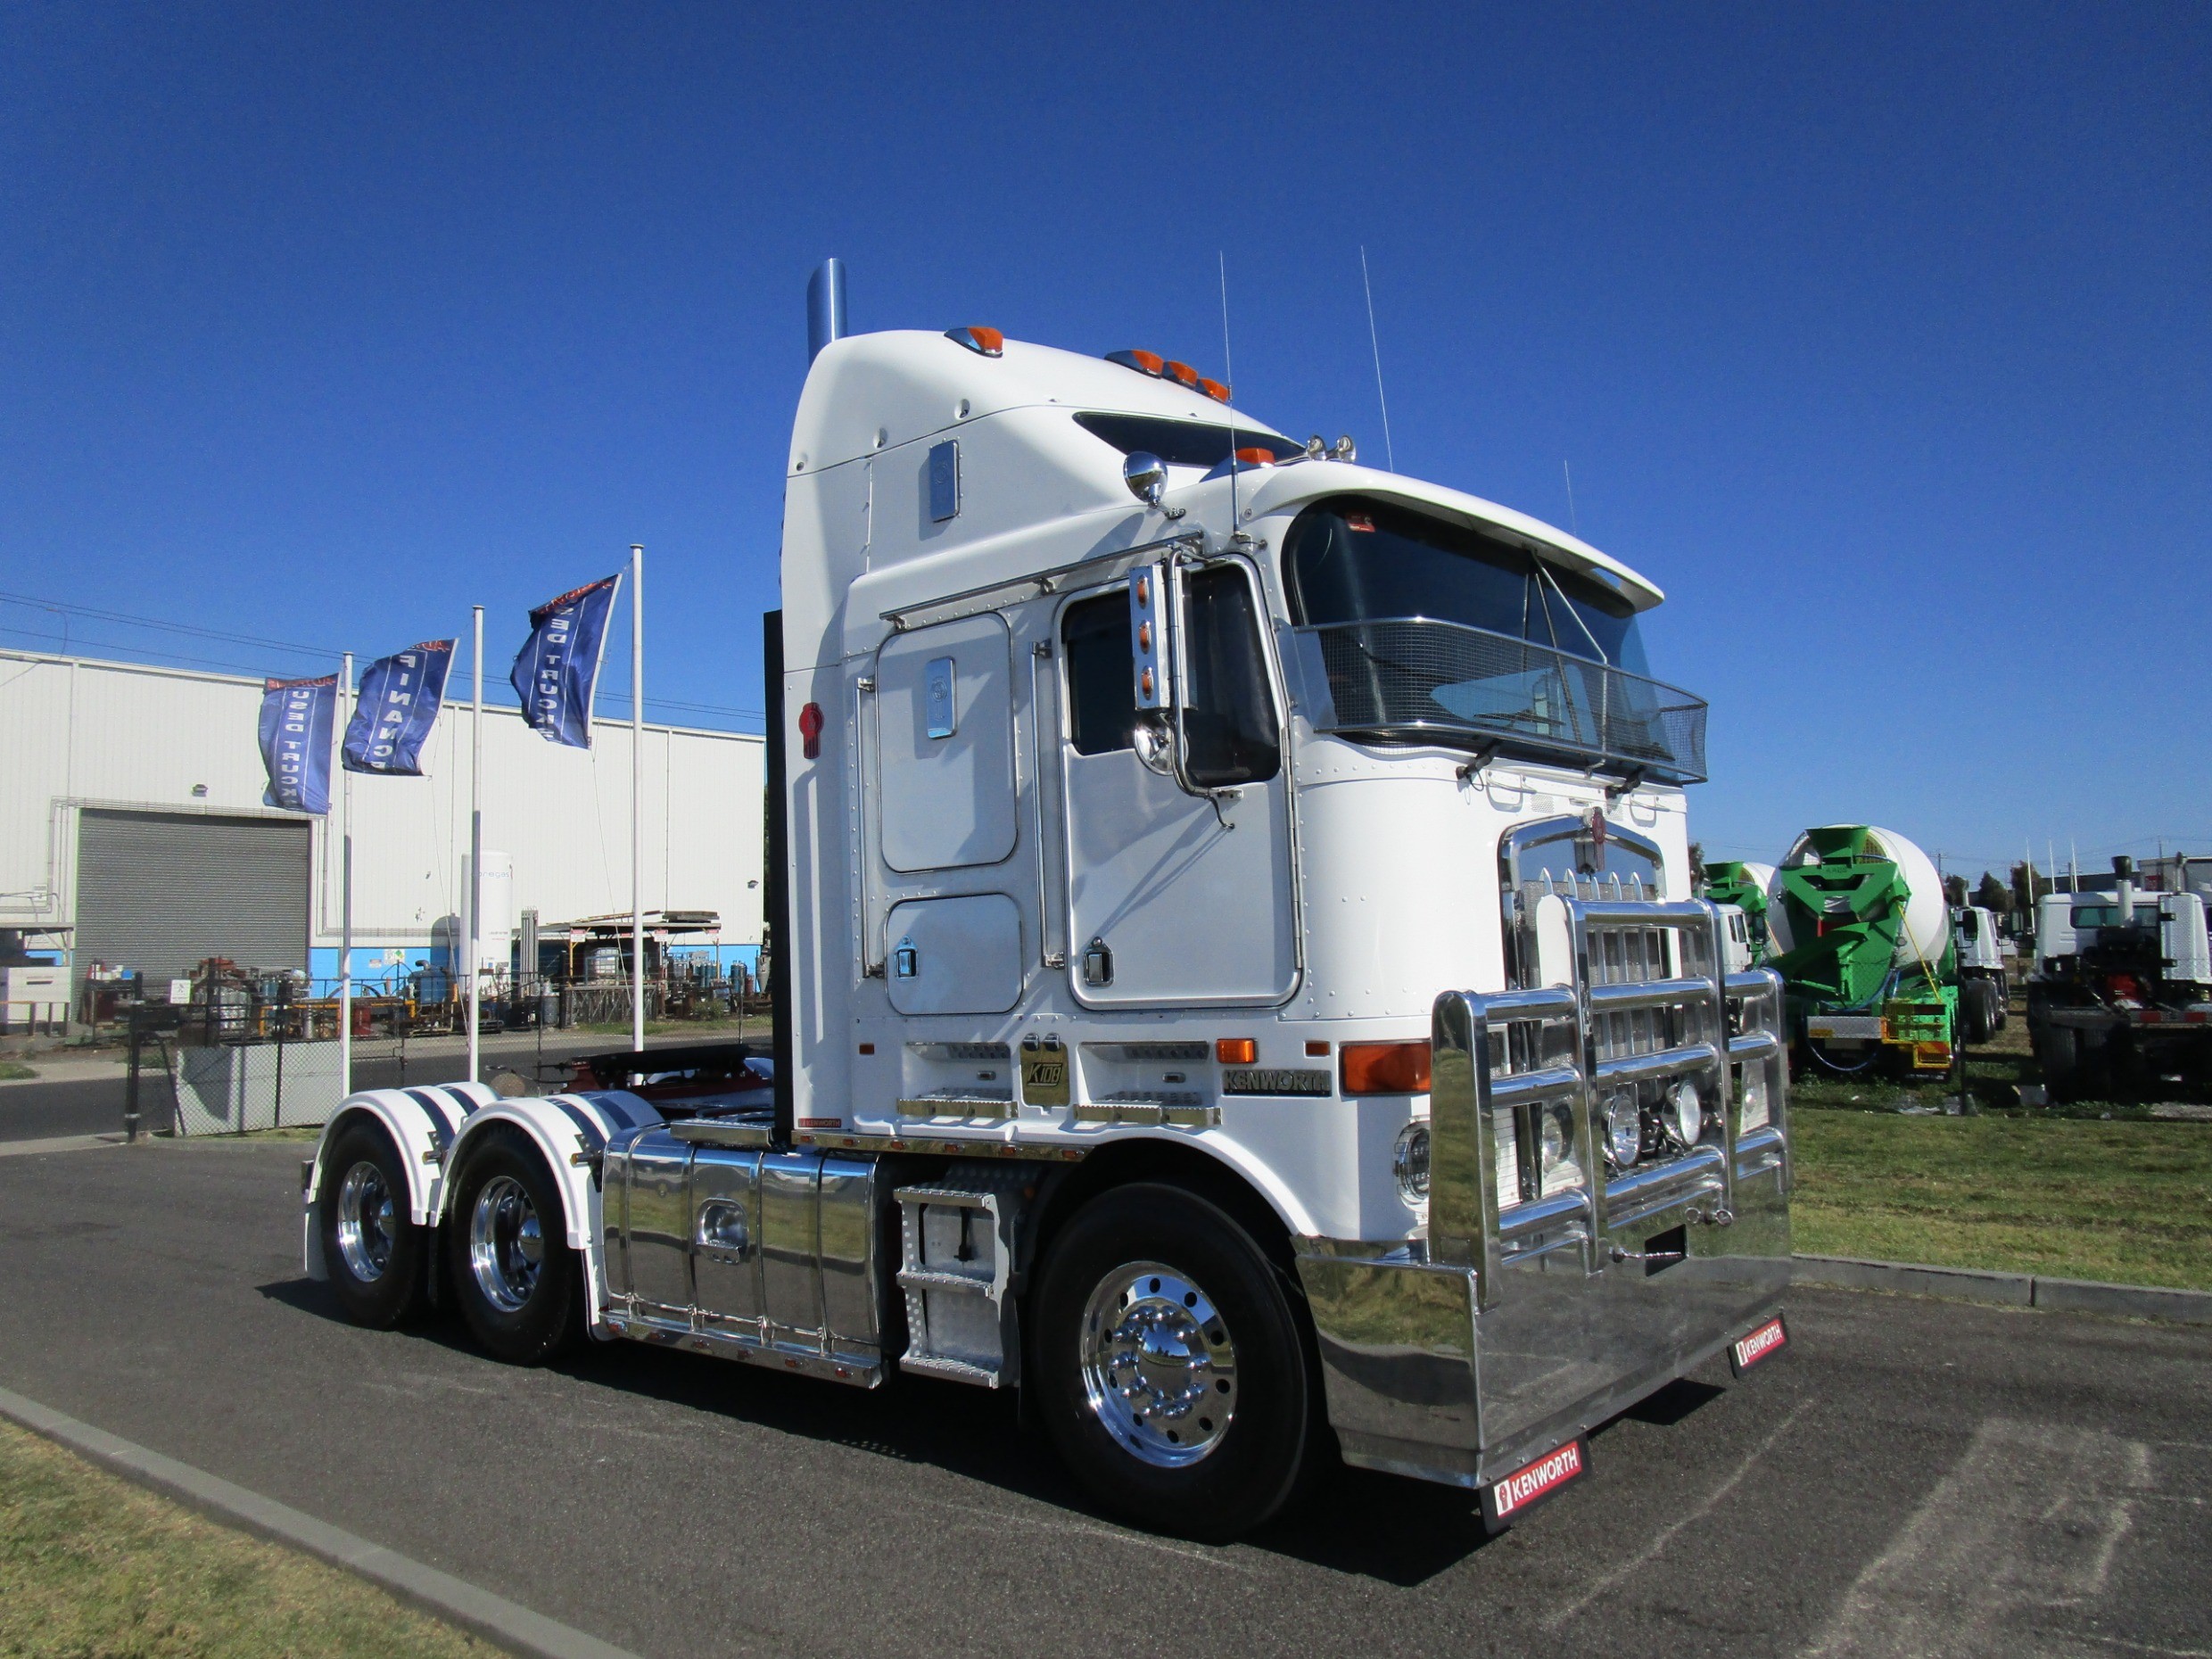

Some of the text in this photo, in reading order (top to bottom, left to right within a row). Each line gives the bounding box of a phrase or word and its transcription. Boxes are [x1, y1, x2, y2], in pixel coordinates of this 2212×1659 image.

[1224, 1070, 1331, 1091] KENWORTH
[1744, 1324, 1783, 1358] KENWORTH
[1512, 1448, 1578, 1501] KENWORTH
